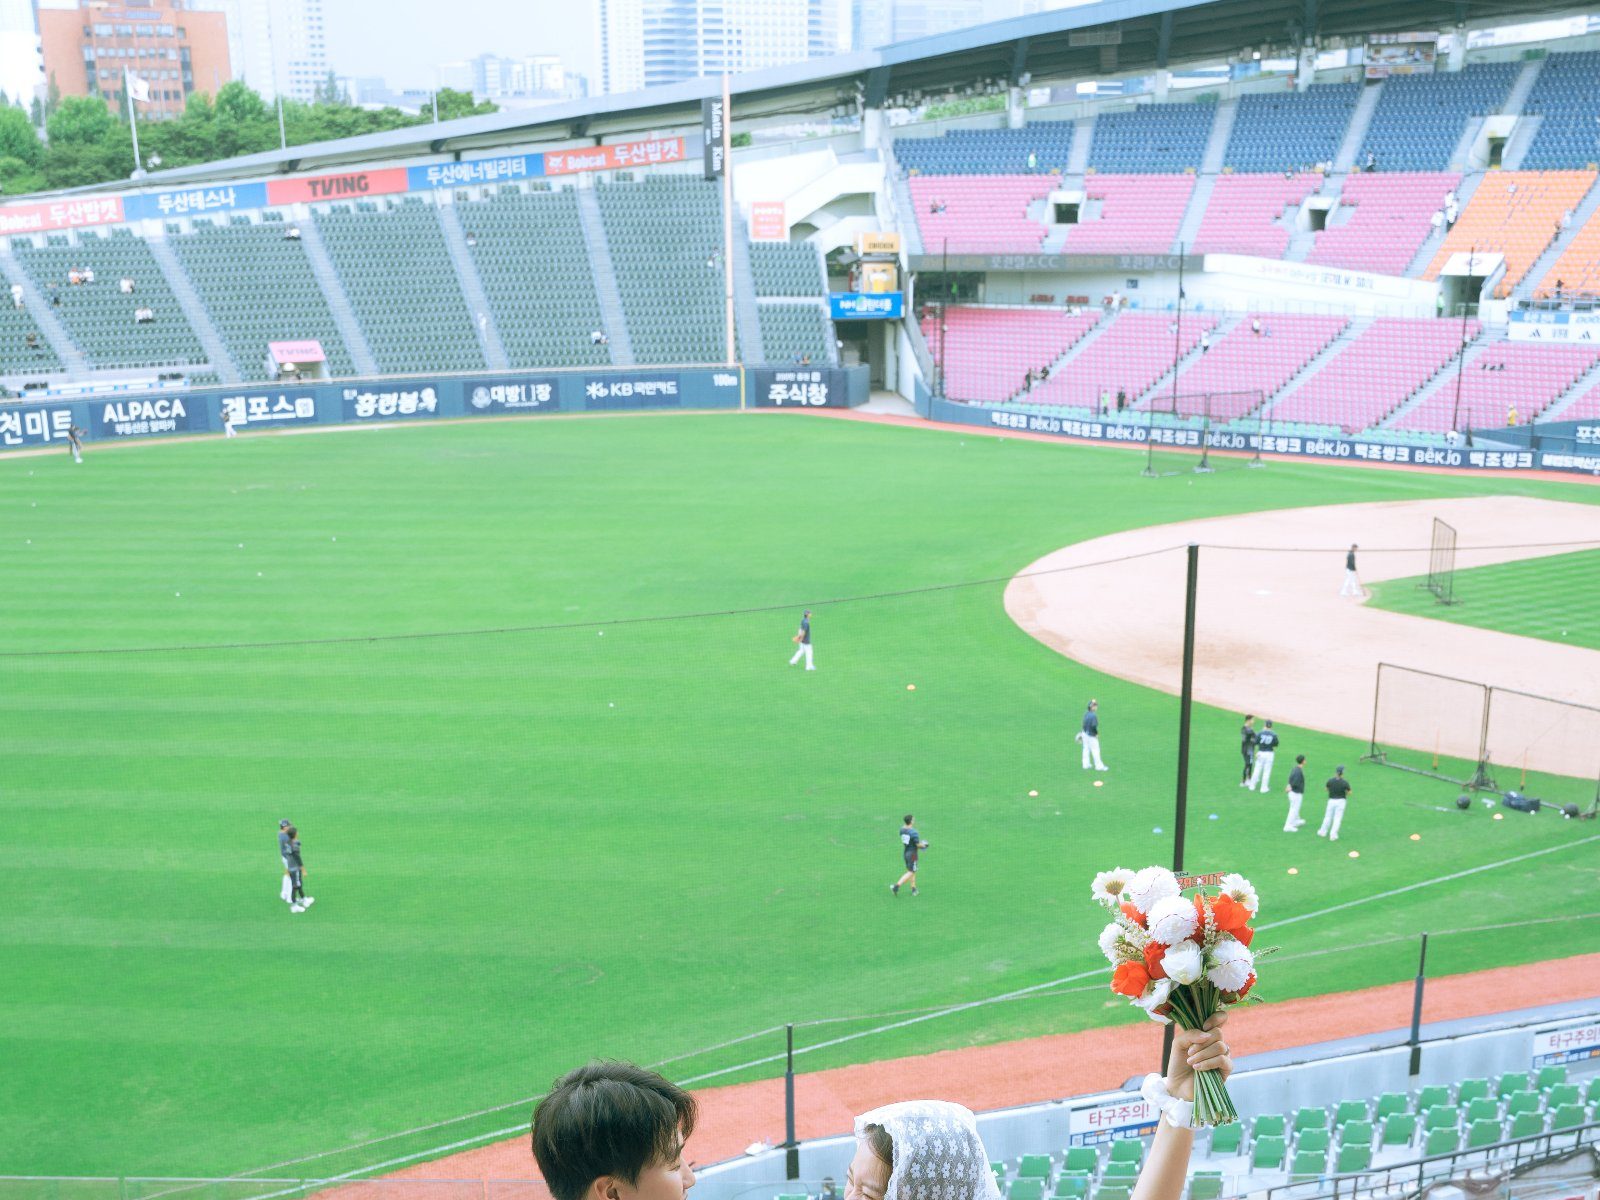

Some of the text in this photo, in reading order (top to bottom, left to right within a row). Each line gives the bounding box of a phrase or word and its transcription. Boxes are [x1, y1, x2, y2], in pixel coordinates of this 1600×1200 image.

[567, 154, 607, 170] Bobcat
[613, 139, 679, 165] 두산밥캣
[426, 157, 527, 185] 두산에너빌리티
[307, 174, 370, 198] TVING
[49, 199, 118, 226] 두산밥캣
[157, 187, 236, 214] 두산테스나
[768, 383, 828, 406] 주식창
[103, 398, 187, 424] ALPACA
[1355, 443, 1410, 462] 백조씽크
[1469, 451, 1533, 469] 백조씽크
[1088, 1103, 1150, 1127] 타구주의!
